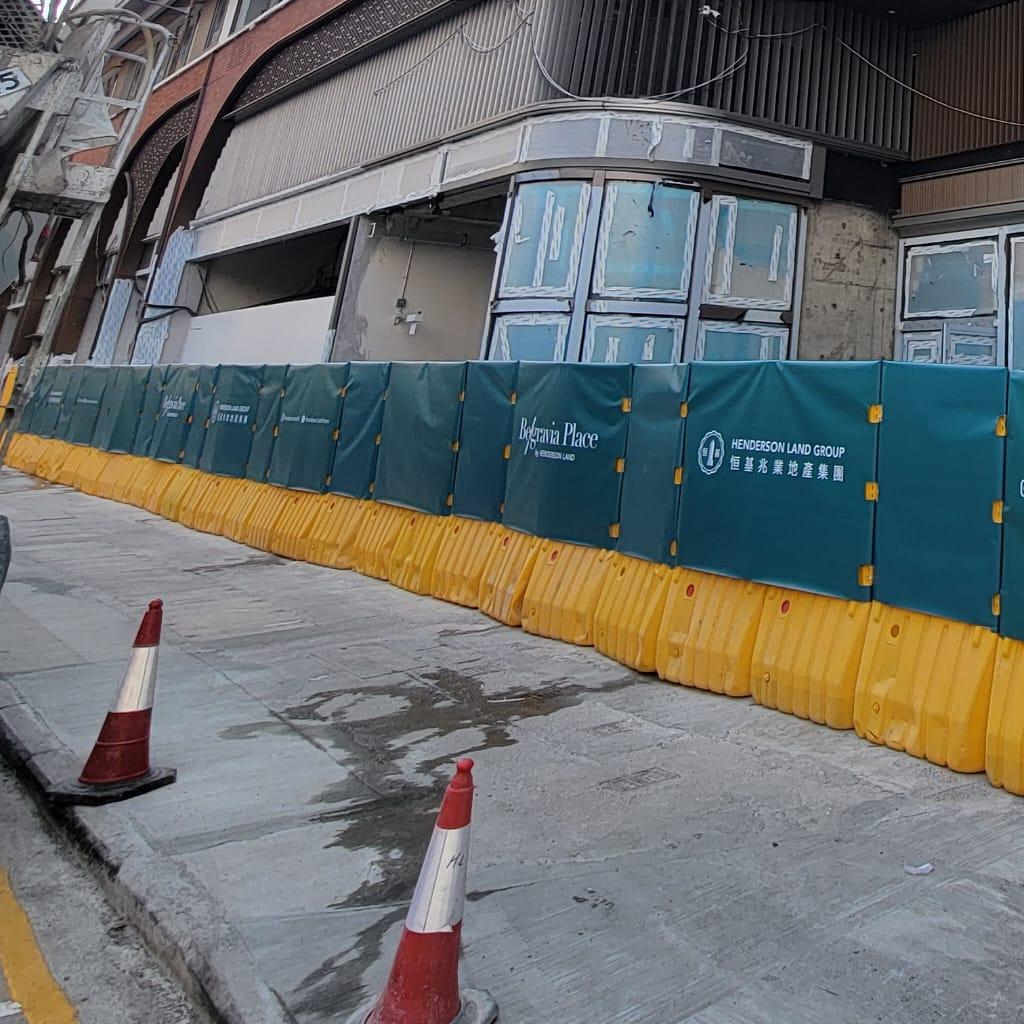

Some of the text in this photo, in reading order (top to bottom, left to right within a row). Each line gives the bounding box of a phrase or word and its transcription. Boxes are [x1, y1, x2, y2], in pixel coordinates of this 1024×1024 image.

[519, 416, 599, 455] Belgravia Place
[731, 438, 786, 453] HENDERSON
[787, 442, 812, 456] LAND
[813, 444, 846, 459] GROUP
[730, 454, 845, 482] 恒基兆業地產集團
